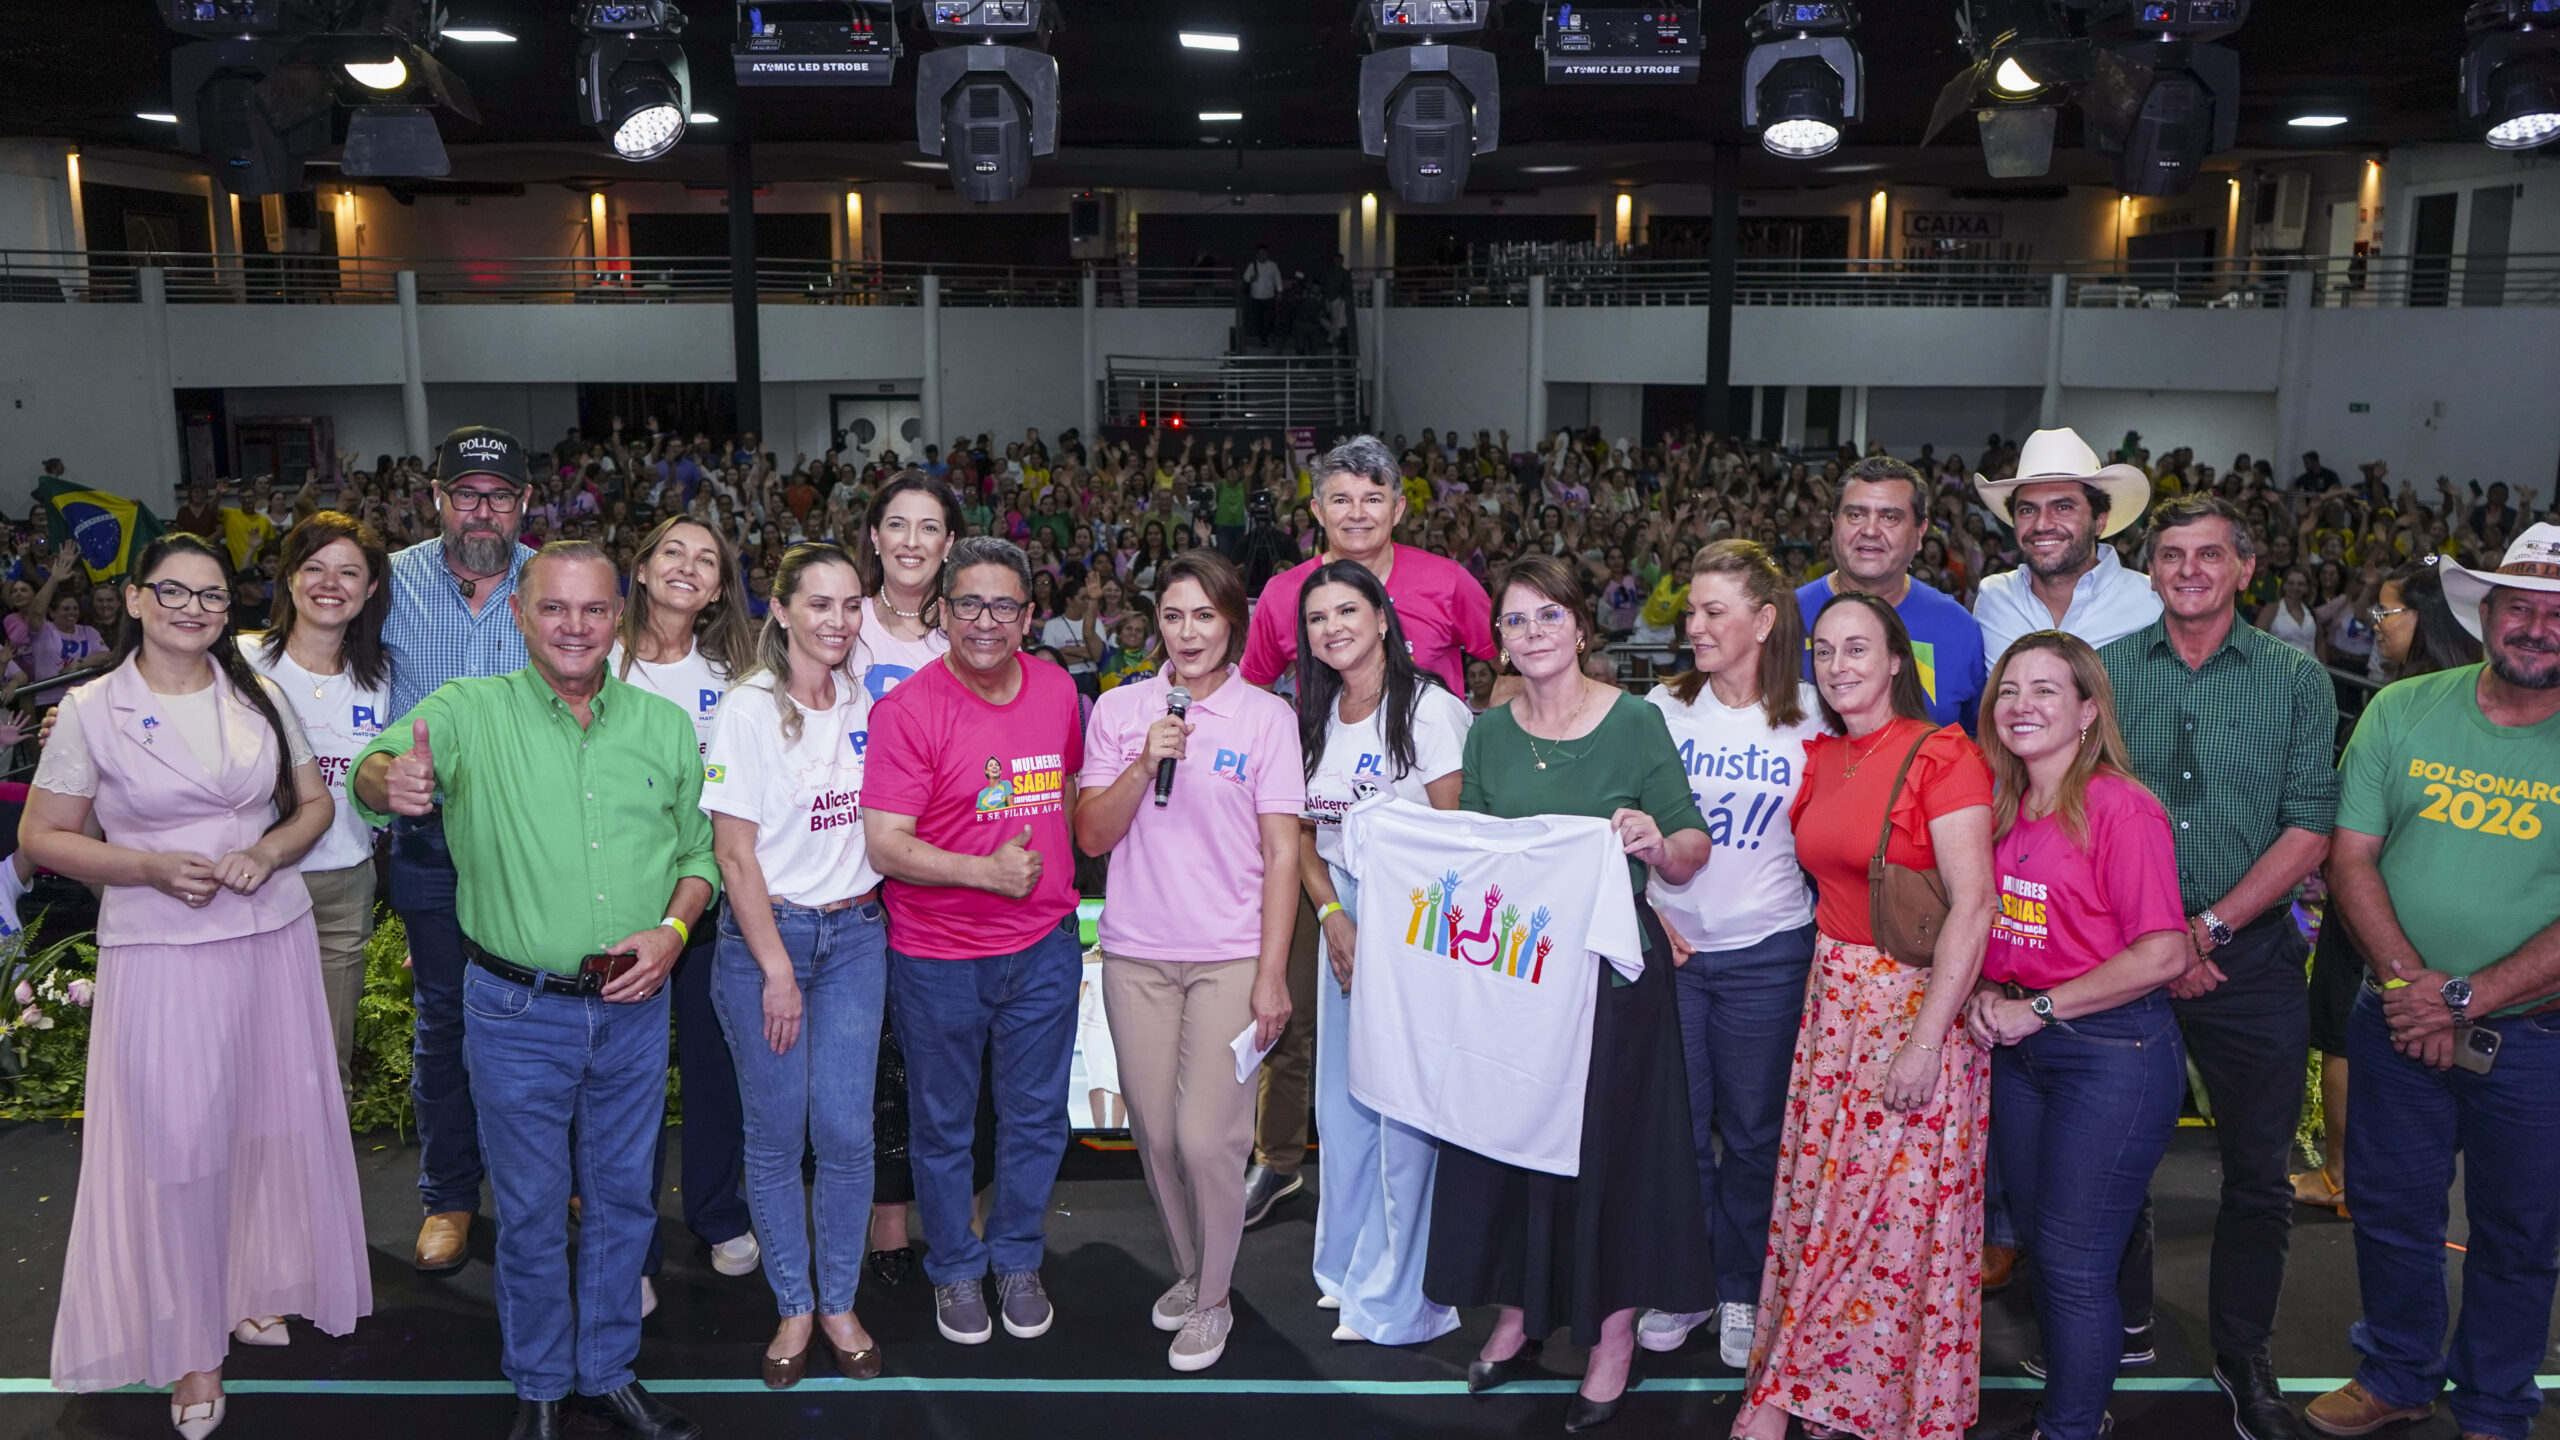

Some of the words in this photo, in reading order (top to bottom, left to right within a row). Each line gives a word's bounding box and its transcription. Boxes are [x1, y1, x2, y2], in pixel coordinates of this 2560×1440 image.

[752, 63, 796, 72] ATOMIC
[798, 63, 820, 72] LED
[822, 63, 869, 72] STROBE
[1565, 66, 1608, 74] ATOMIC
[1610, 66, 1632, 74] LED
[1634, 66, 1680, 74] STROBE
[1913, 215, 1990, 233] CAIXA
[458, 438, 508, 454] POLLON
[142, 716, 160, 729] PL
[352, 705, 383, 728] PL
[1011, 754, 1062, 774] MULHERES
[1214, 748, 1248, 782] PL
[1355, 753, 1382, 776] PL
[1678, 738, 1790, 786] Anistia
[1013, 770, 1063, 795] SÁBIAS
[810, 806, 857, 832] Brasil
[988, 812, 1000, 820] SE
[1004, 806, 1038, 818] FILIAM
[2418, 782, 2542, 840] 2026
[2010, 935, 2024, 946] AO
[2030, 938, 2046, 950] PL
